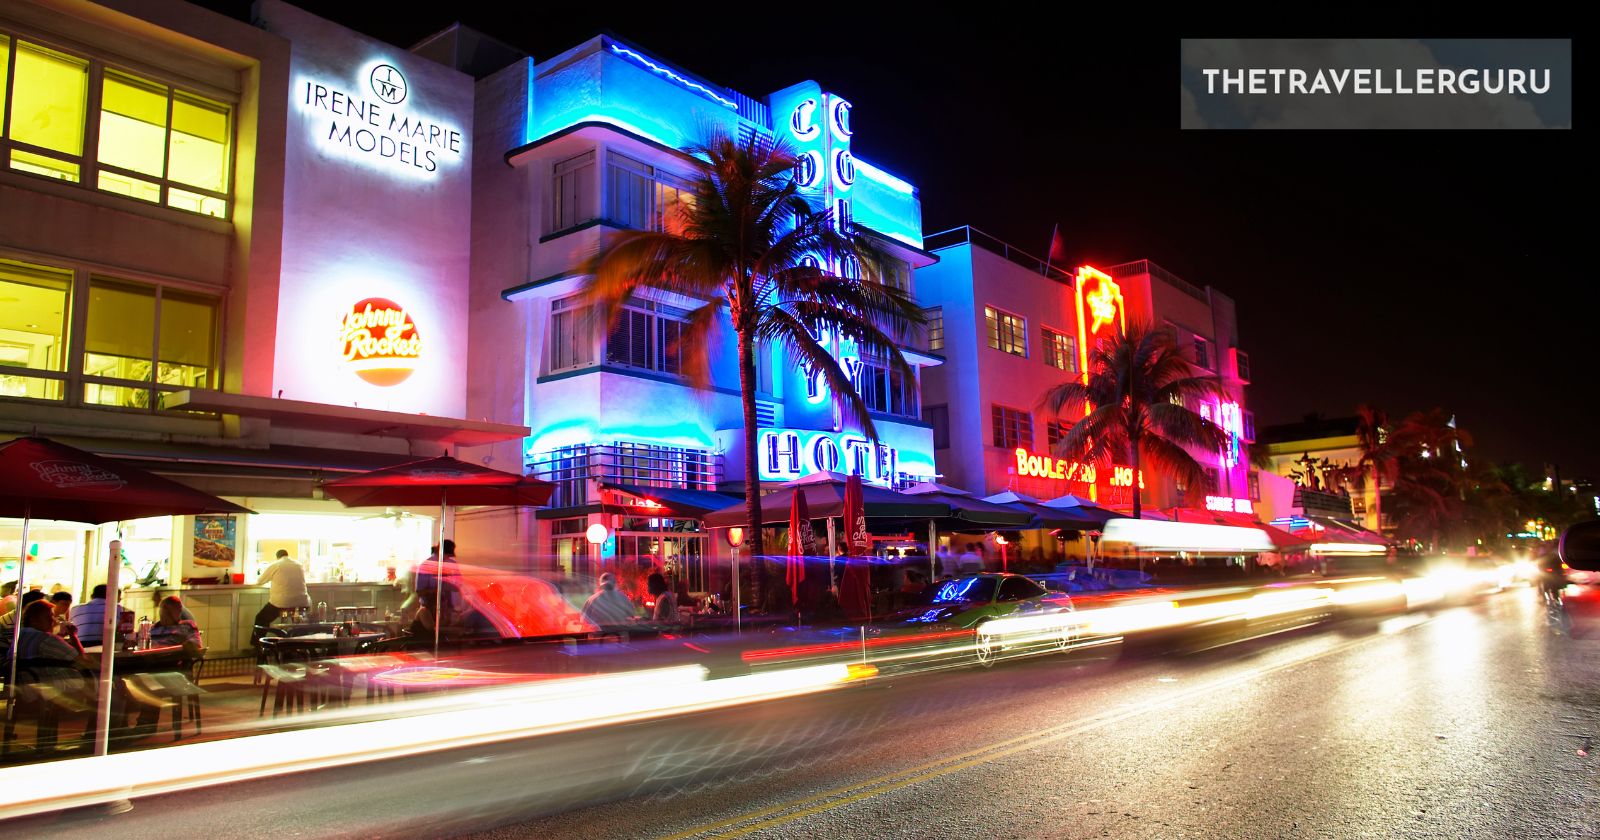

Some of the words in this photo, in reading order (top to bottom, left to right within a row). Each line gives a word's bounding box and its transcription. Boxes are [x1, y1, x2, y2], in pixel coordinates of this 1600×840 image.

[305, 82, 380, 127] IRENE
[388, 112, 461, 154] MARIE
[328, 121, 436, 172] MODELS
[832, 98, 865, 397] COLOY
[1016, 447, 1097, 483] BOULEVRD
